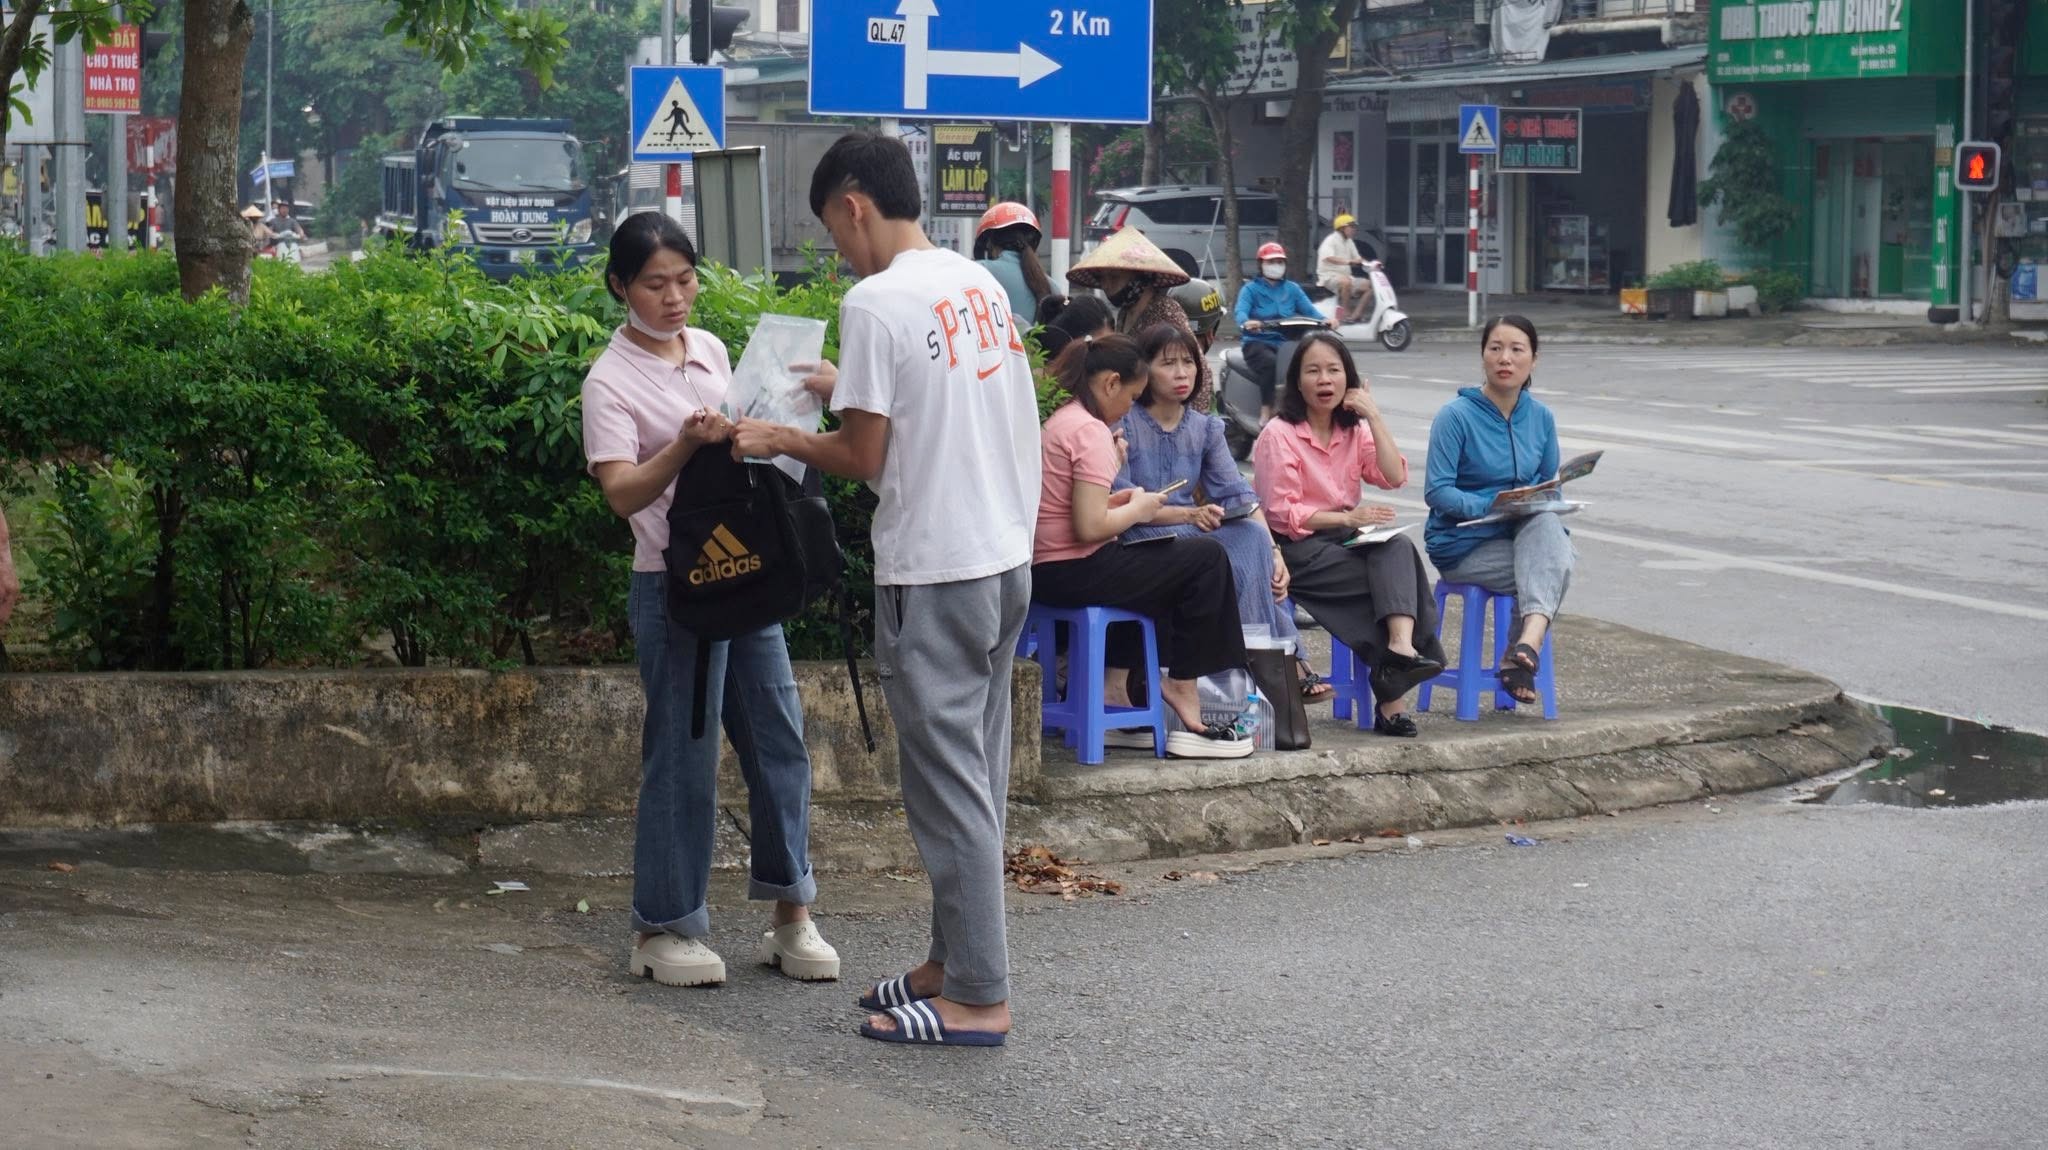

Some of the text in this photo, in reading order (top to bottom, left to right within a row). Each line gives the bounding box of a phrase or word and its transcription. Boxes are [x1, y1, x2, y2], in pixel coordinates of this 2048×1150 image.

[1050, 9, 1111, 36] 2 Km
[1889, 0, 1902, 31] 2
[870, 22, 905, 43] QL.47
[86, 52, 138, 69] CHO THUÊ
[89, 74, 136, 95] NHÀ TRỌ
[962, 151, 982, 161] QUY
[1567, 145, 1577, 167] 1
[942, 164, 966, 191] LÀM
[491, 208, 519, 223] HOÀN
[689, 554, 762, 585] adidas
